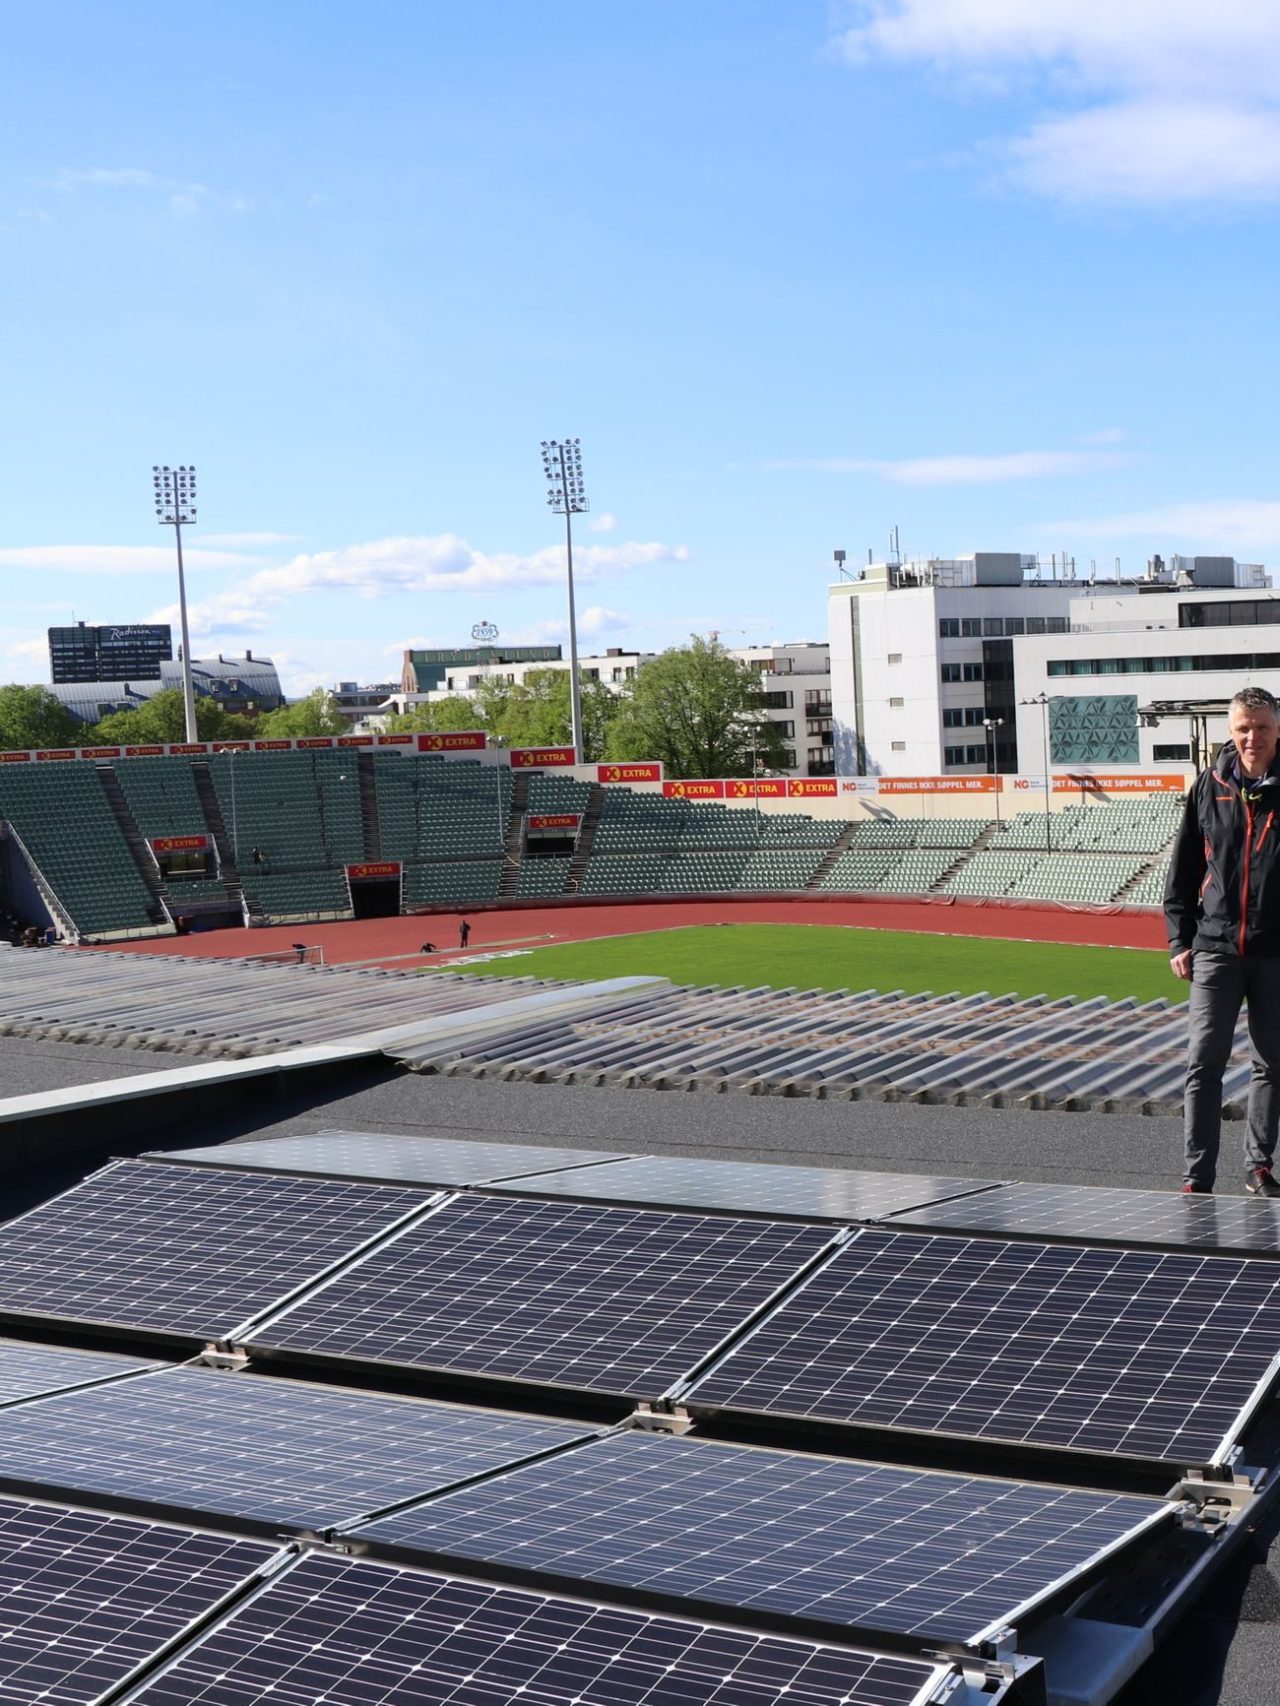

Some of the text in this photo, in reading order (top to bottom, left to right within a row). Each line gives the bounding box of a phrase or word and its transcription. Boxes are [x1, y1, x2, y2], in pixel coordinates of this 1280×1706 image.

[446, 738, 476, 747] EXTRA
[536, 754, 566, 762] EXTRA
[622, 769, 652, 778] EXTRA
[937, 781, 964, 789] SØPPEL
[966, 780, 983, 789] MER.
[1052, 780, 1065, 788] DET
[1115, 779, 1143, 788] SØPPEL
[1145, 779, 1164, 788] MER.
[686, 786, 716, 794] EXTRA
[749, 785, 778, 793] EXTRA
[805, 784, 835, 793] EXTRA
[174, 839, 198, 847] EXTRA
